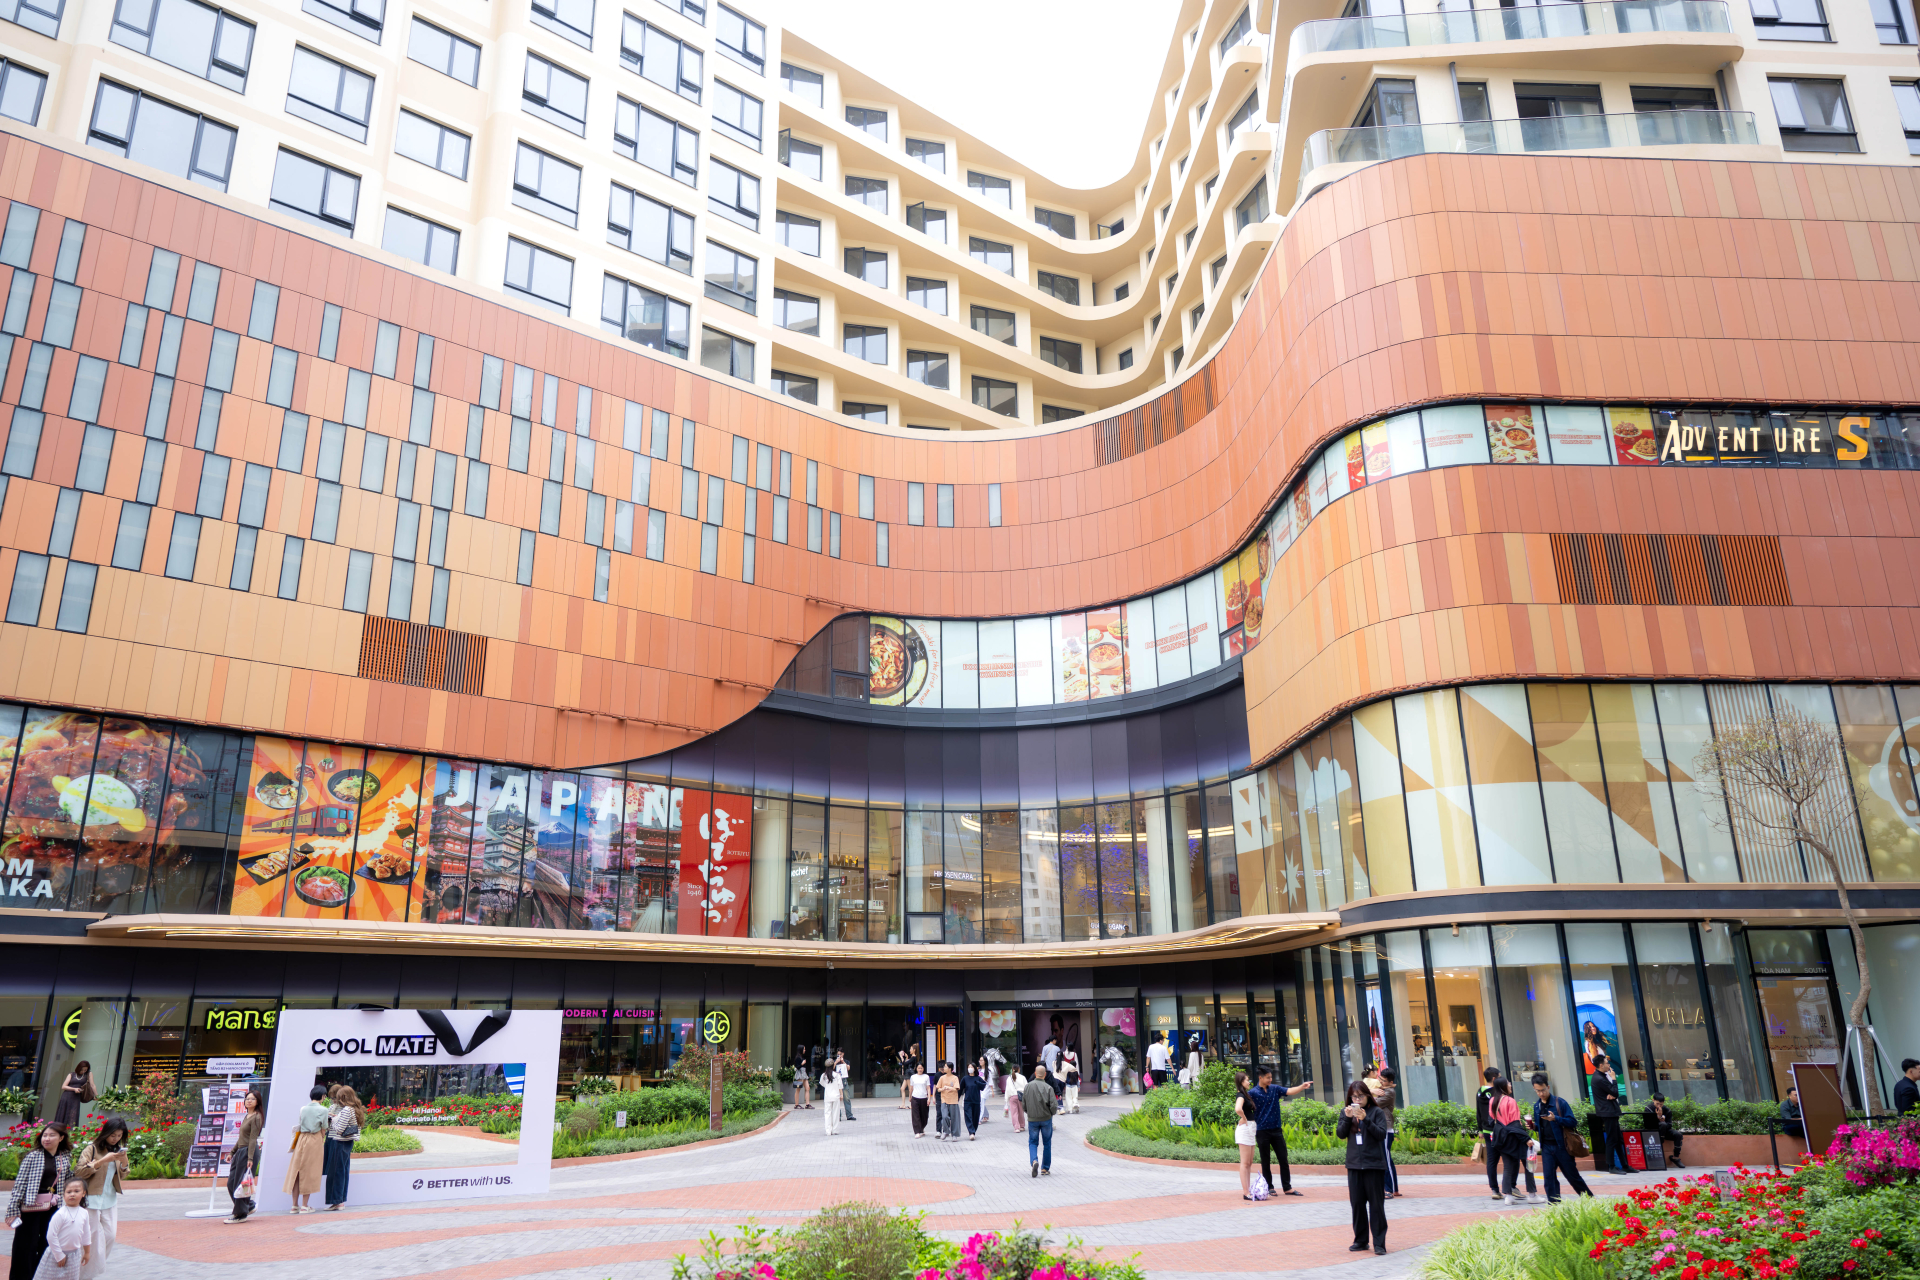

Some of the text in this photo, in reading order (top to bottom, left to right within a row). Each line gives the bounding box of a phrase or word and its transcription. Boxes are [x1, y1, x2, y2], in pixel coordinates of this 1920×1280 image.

[929, 649, 938, 659] for
[445, 769, 675, 828] JAPAN
[312, 1036, 436, 1055] COOL MATE
[427, 1178, 468, 1189] BETTER
[470, 1175, 493, 1186] with
